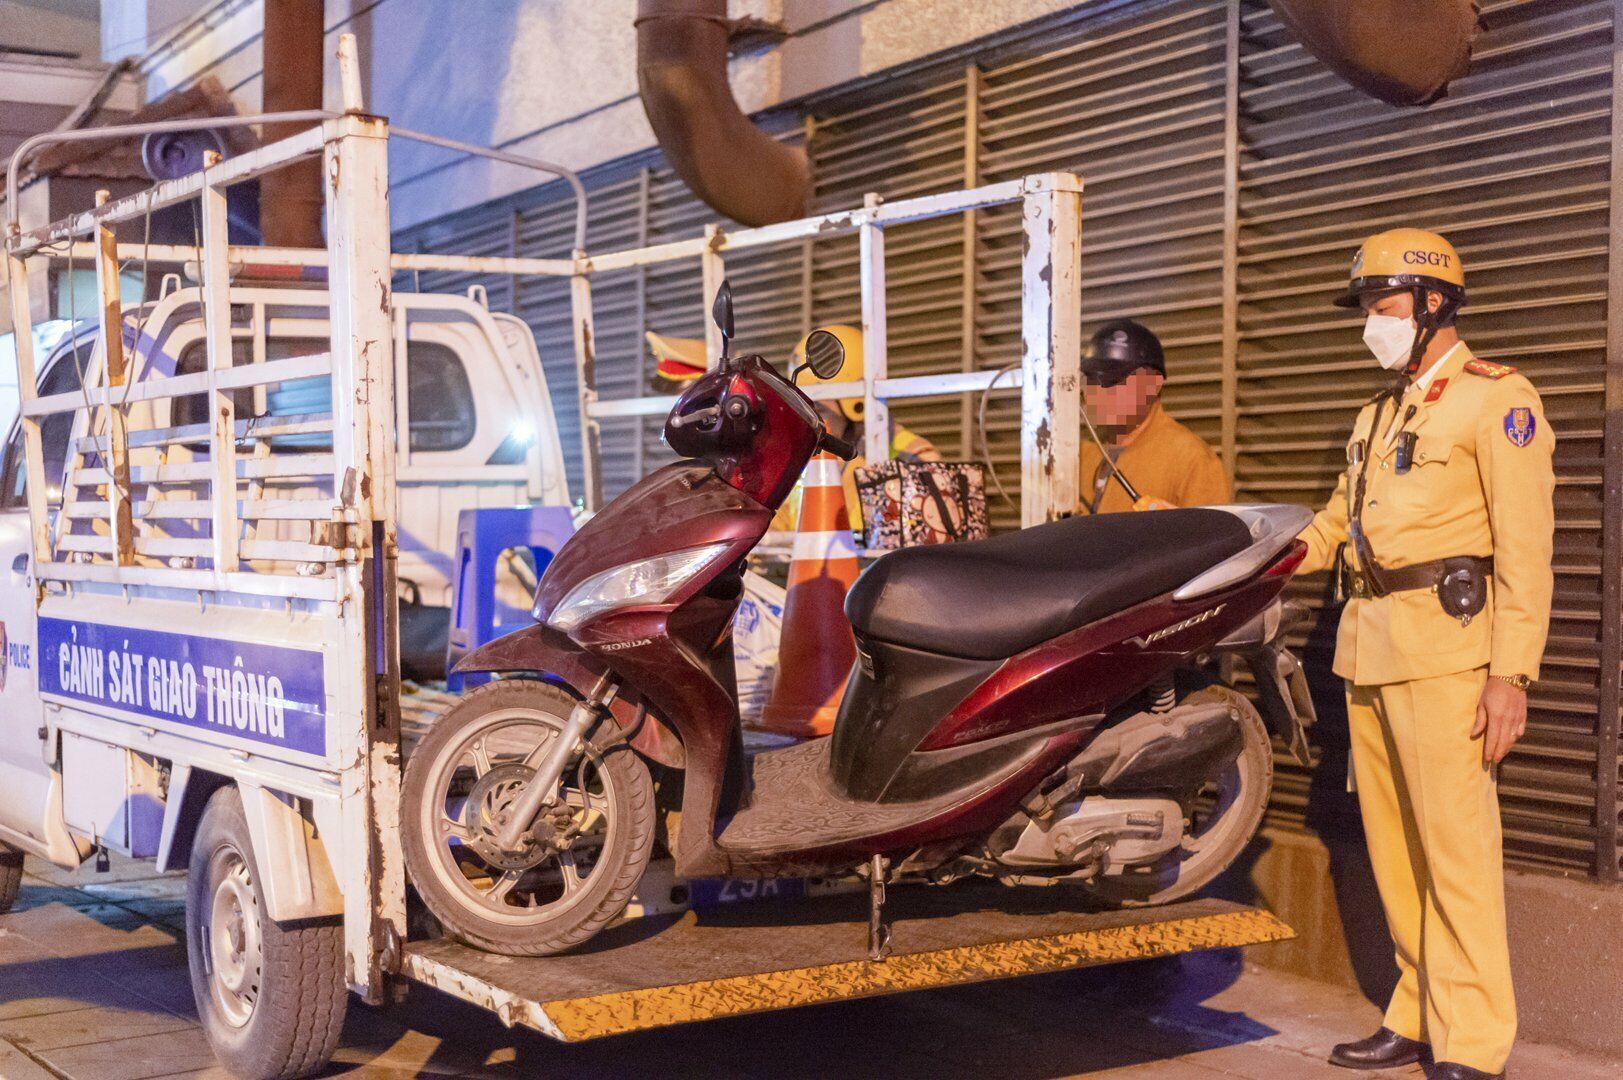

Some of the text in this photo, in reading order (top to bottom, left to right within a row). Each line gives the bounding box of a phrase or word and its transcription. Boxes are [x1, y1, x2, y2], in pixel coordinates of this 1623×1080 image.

[1403, 250, 1451, 268] CSGT
[1121, 602, 1228, 649] VISION
[9, 642, 30, 669] POLICE
[601, 638, 653, 651] HONDA
[59, 624, 286, 738] CẢNH SÁT GIAO THÔNG
